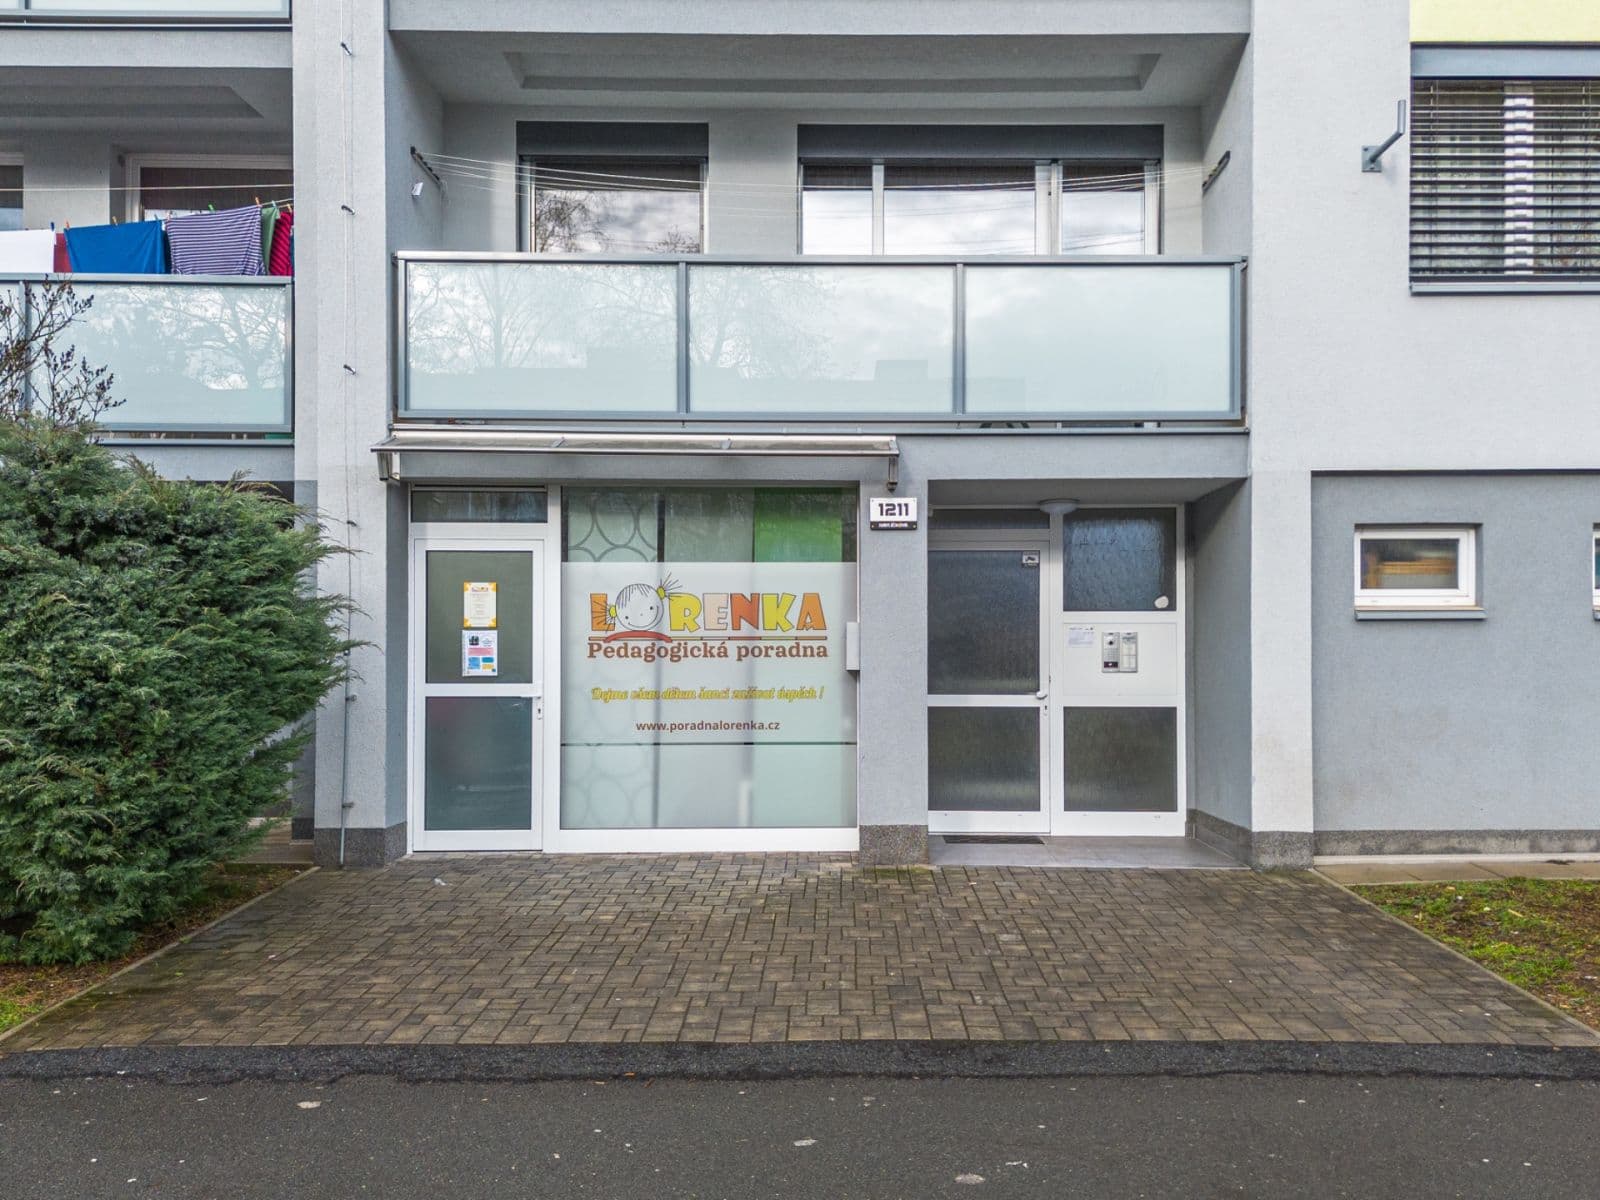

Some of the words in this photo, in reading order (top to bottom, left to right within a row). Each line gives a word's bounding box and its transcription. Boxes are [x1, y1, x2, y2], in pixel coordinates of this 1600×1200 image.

[878, 503, 909, 516] 1211
[587, 642, 729, 662] Pedagogická
[736, 643, 828, 661] poradna
[636, 720, 780, 733] www.poradnalorenka.cz
